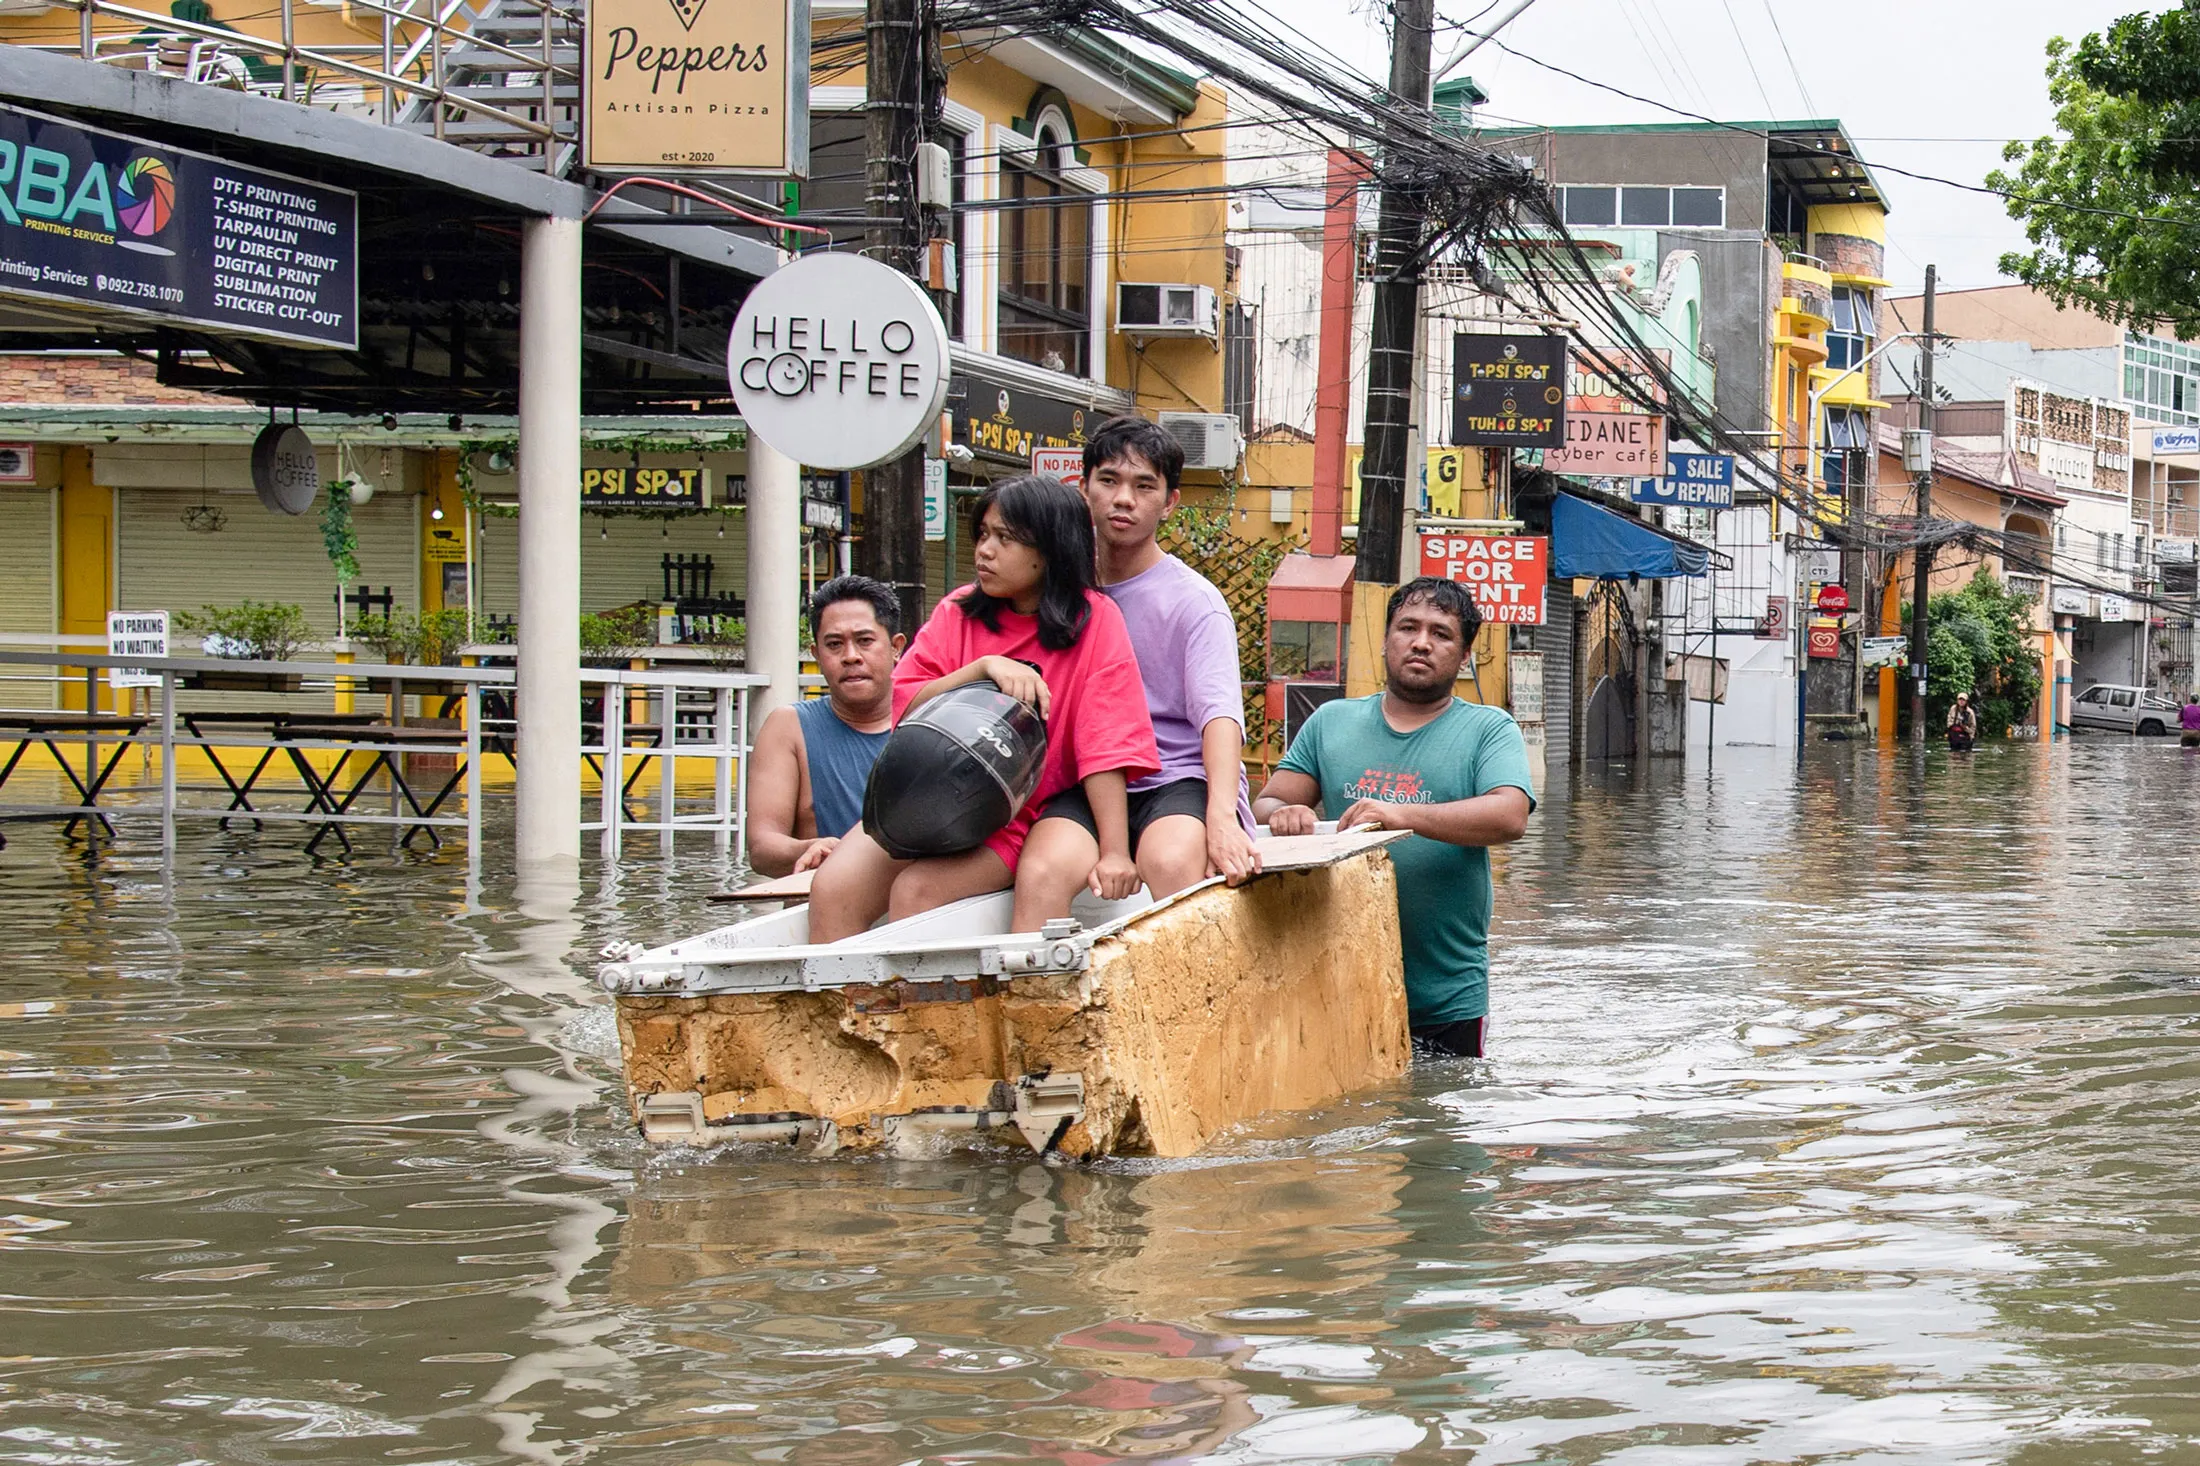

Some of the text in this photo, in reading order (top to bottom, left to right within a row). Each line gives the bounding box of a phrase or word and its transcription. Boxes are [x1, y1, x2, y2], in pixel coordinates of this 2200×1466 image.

[604, 27, 768, 94] Peppers
[608, 103, 769, 115] Artisan Pizza
[662, 152, 715, 163] est 2020
[213, 176, 317, 212] DTF PRINTING
[214, 196, 337, 235] T-SHIRT PRINTING
[25, 219, 115, 245] PRINTING SERVICES
[214, 215, 298, 245] TARPAULIN
[214, 235, 339, 272] UV DIRECT PRINT
[0, 257, 184, 303] rinting Services 0922.758.1070
[214, 255, 322, 286] DIGITAL PRINT
[214, 274, 317, 304] SUBLIMATION
[214, 293, 343, 327] STICKER CUT-OUT
[753, 315, 914, 355] HELLO
[740, 352, 920, 398] COFFEE
[276, 451, 315, 471] HELLO
[1043, 459, 1060, 471] NO
[1551, 446, 1659, 463] cyber café
[275, 466, 318, 489] COFFEE
[1687, 458, 1723, 480] SALE
[1677, 481, 1730, 504] REPAIR
[1425, 538, 1535, 560] SPACE
[1446, 560, 1515, 581] FOR
[1499, 605, 1537, 623] 0735
[113, 619, 164, 634] NO PARKING
[113, 639, 164, 655] NO WAITING
